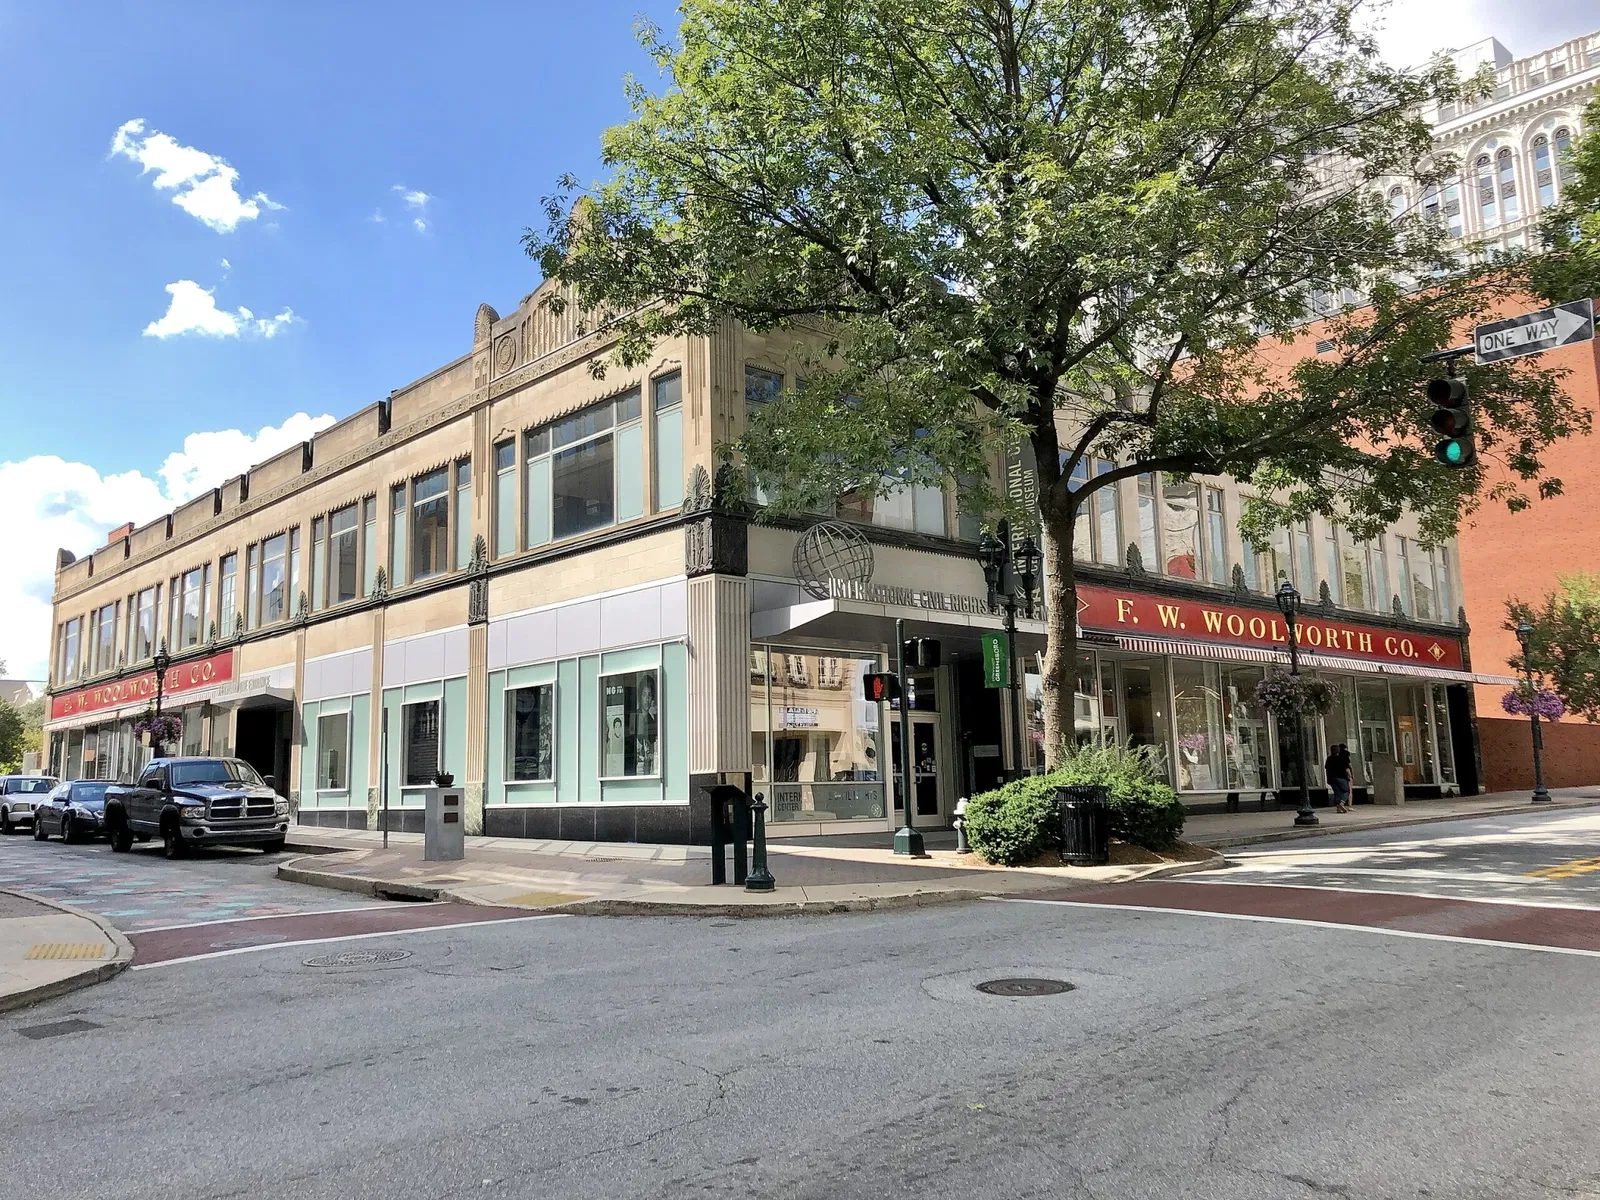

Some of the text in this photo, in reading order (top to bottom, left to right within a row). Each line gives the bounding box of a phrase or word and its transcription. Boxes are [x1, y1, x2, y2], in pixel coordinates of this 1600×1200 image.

[1484, 319, 1559, 351] ONE WAY
[950, 593, 988, 615] RIGHTS
[1116, 598, 1420, 659] F. W. WOOLWORTH CO.
[992, 639, 1000, 682] GREENSBORO
[78, 694, 88, 709] W.
[190, 662, 216, 684] CO.
